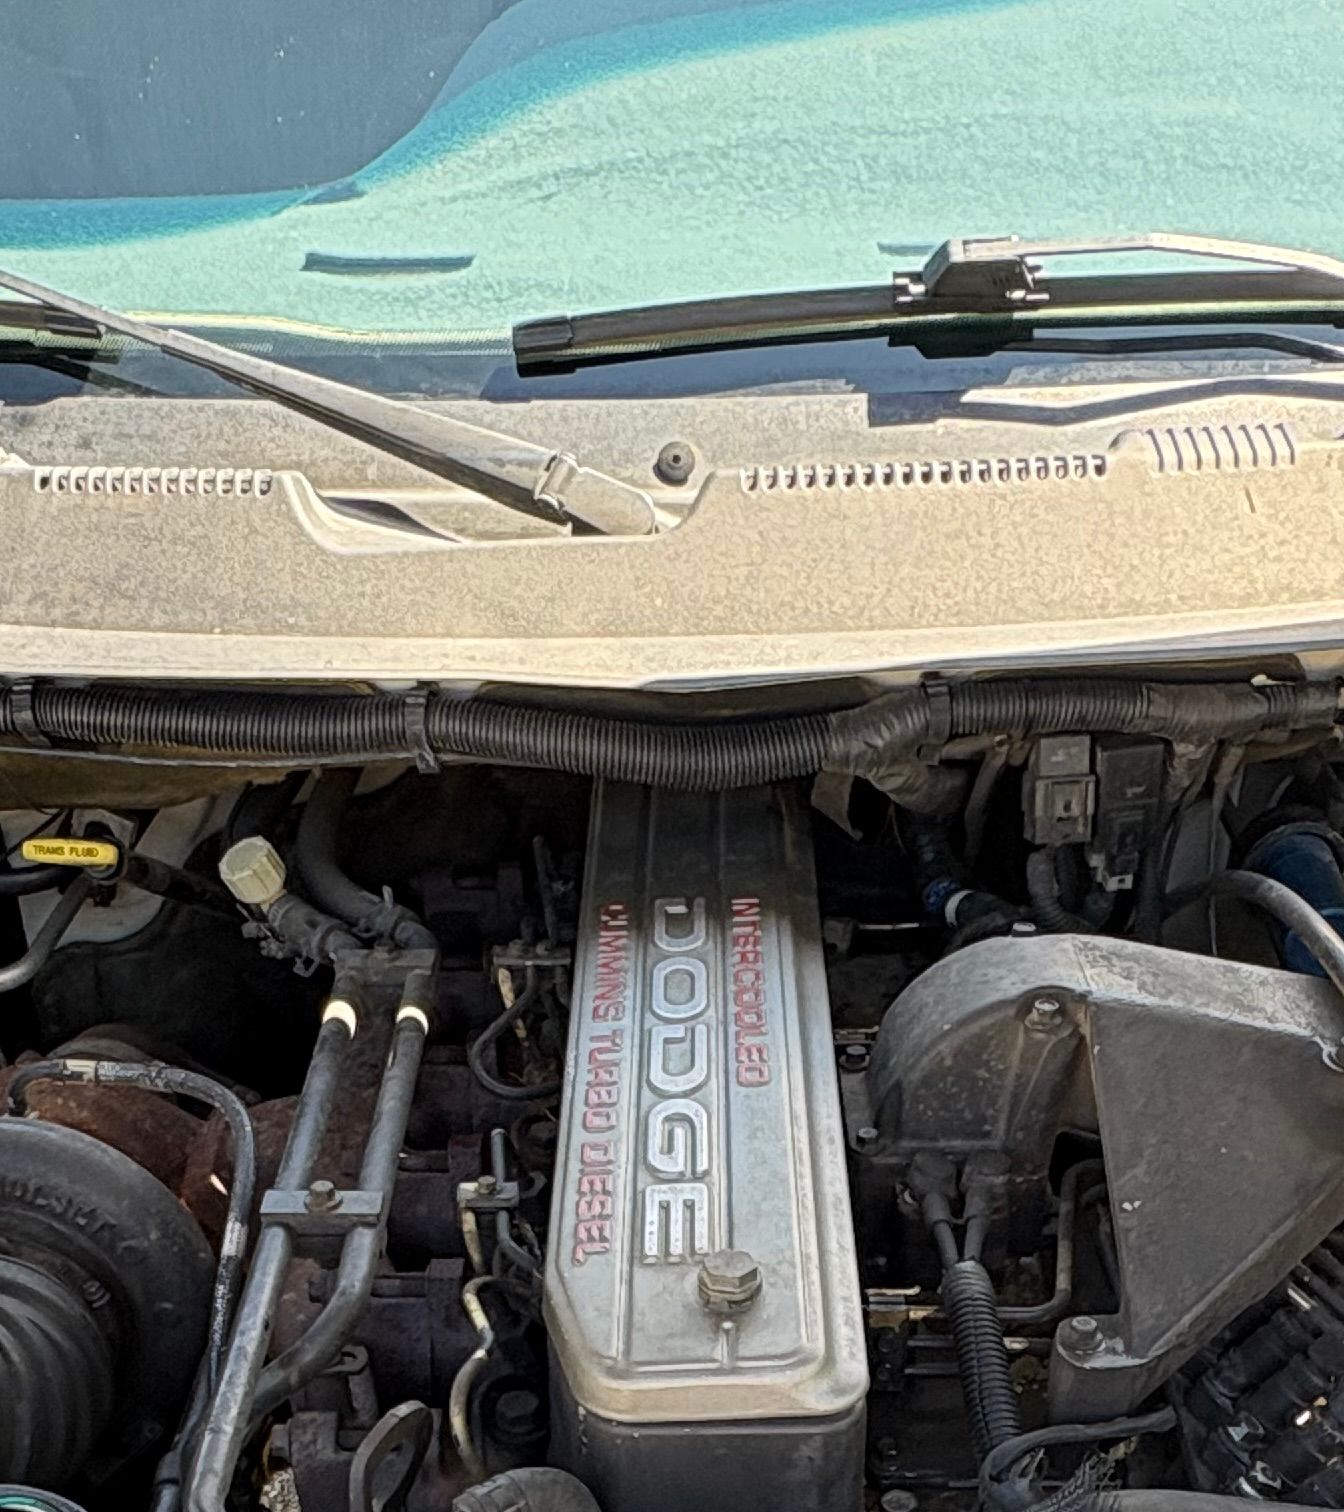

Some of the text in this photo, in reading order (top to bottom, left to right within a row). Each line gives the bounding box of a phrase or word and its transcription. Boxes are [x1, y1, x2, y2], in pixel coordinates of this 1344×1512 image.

[32, 845, 99, 857] TRANS FLUID
[573, 904, 630, 1266] CUMMINS TURBO DIESEL
[641, 897, 710, 1264] DODGE
[731, 898, 772, 1088] INTERCOOLED
